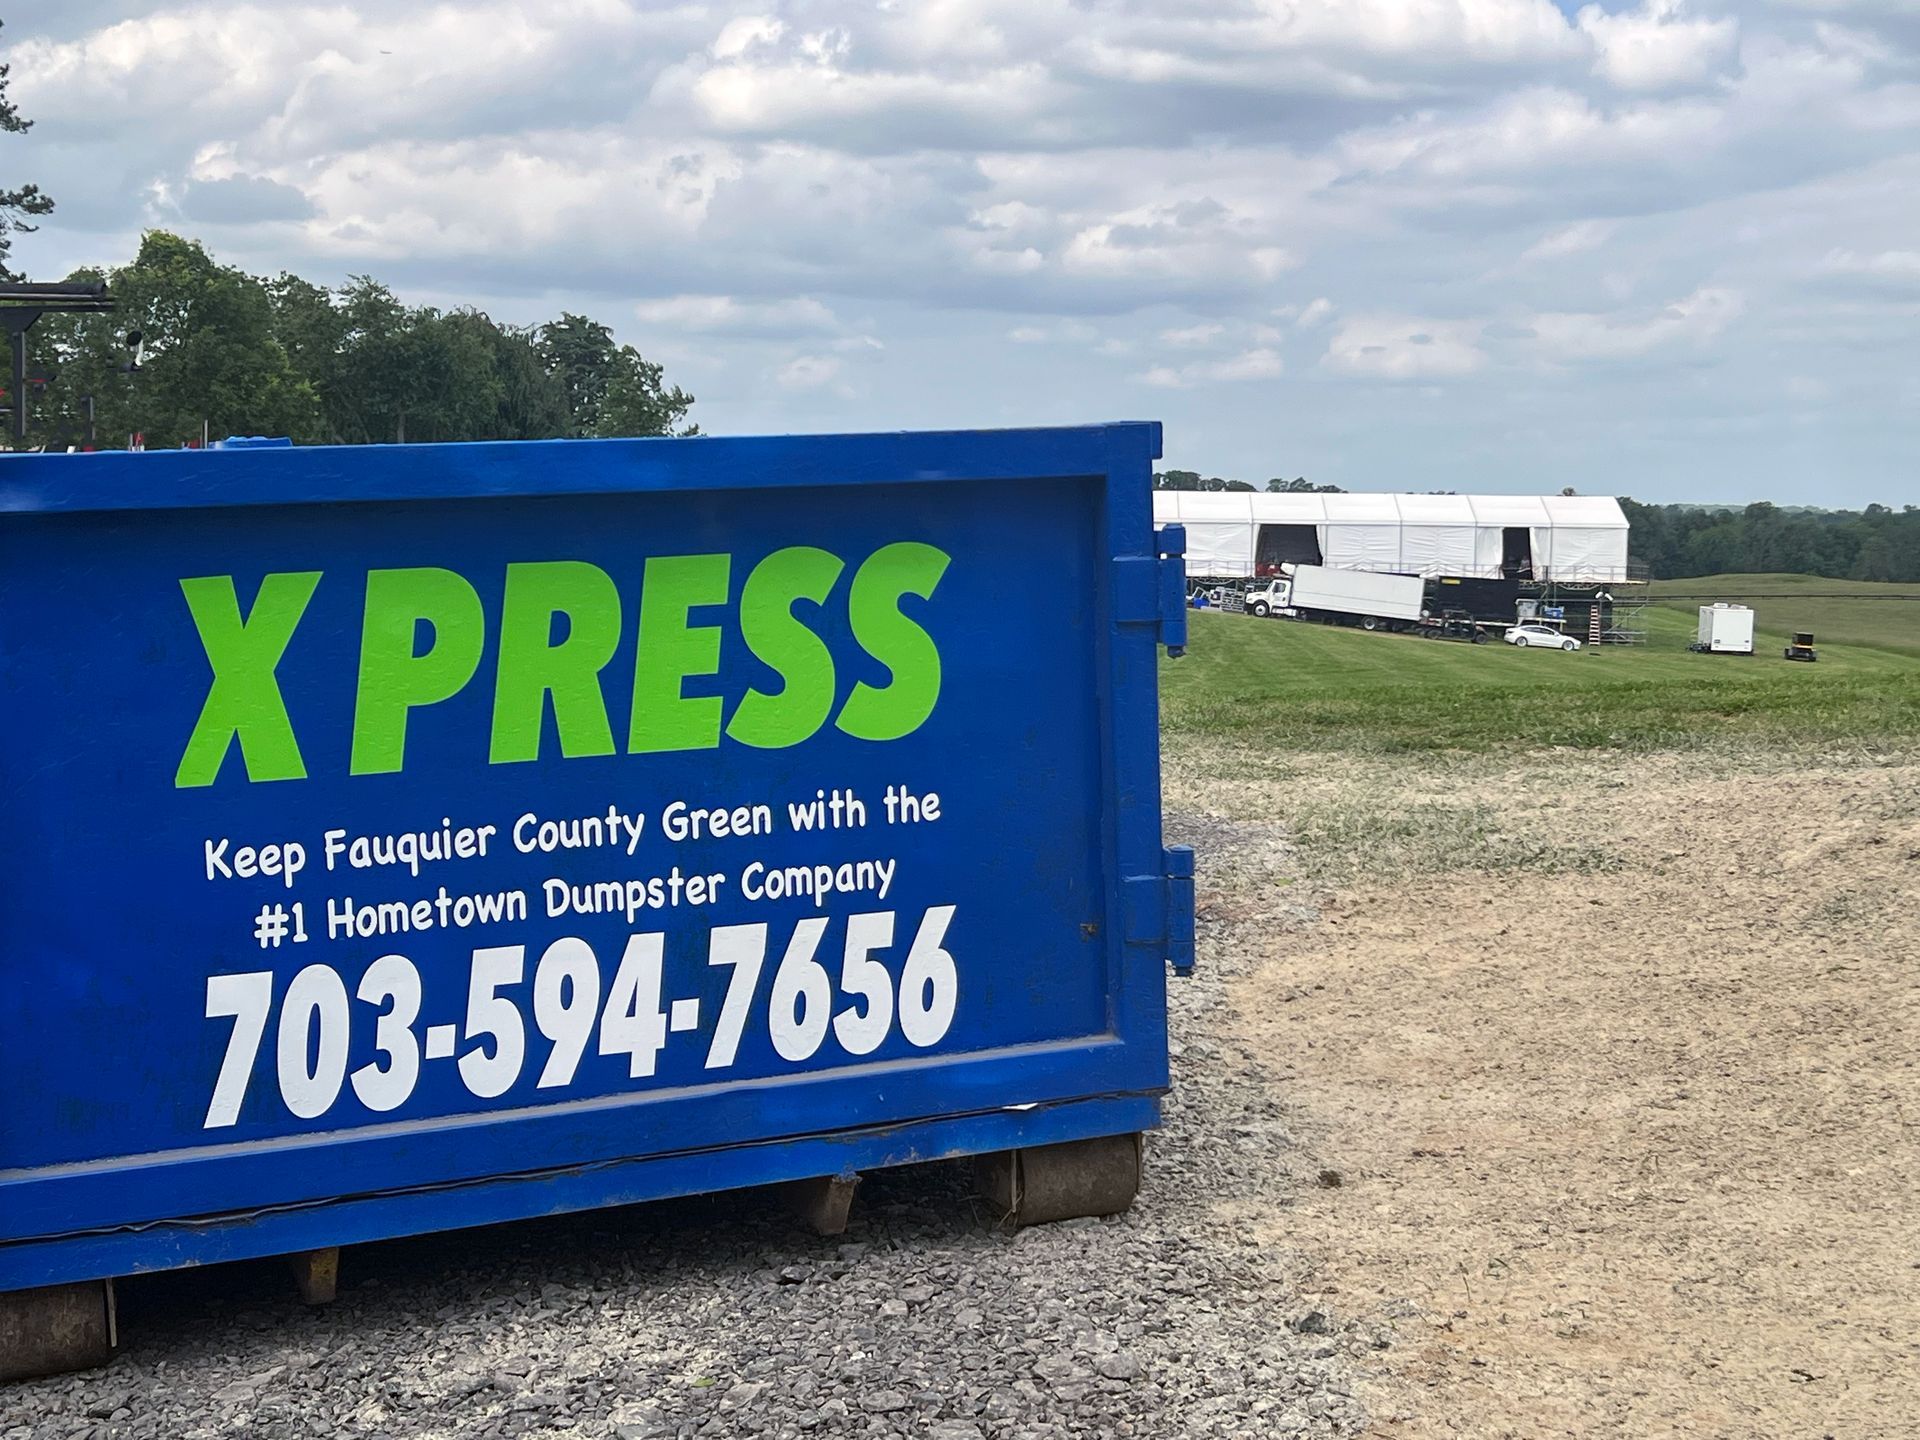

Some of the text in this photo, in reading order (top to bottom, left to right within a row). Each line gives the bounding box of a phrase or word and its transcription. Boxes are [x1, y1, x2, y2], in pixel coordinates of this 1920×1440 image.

[205, 784, 941, 889] Keep Fauquier County Green with the
[253, 858, 897, 949] #1 Hometown Dumpster Company
[203, 904, 958, 1129] 703-594-7656
